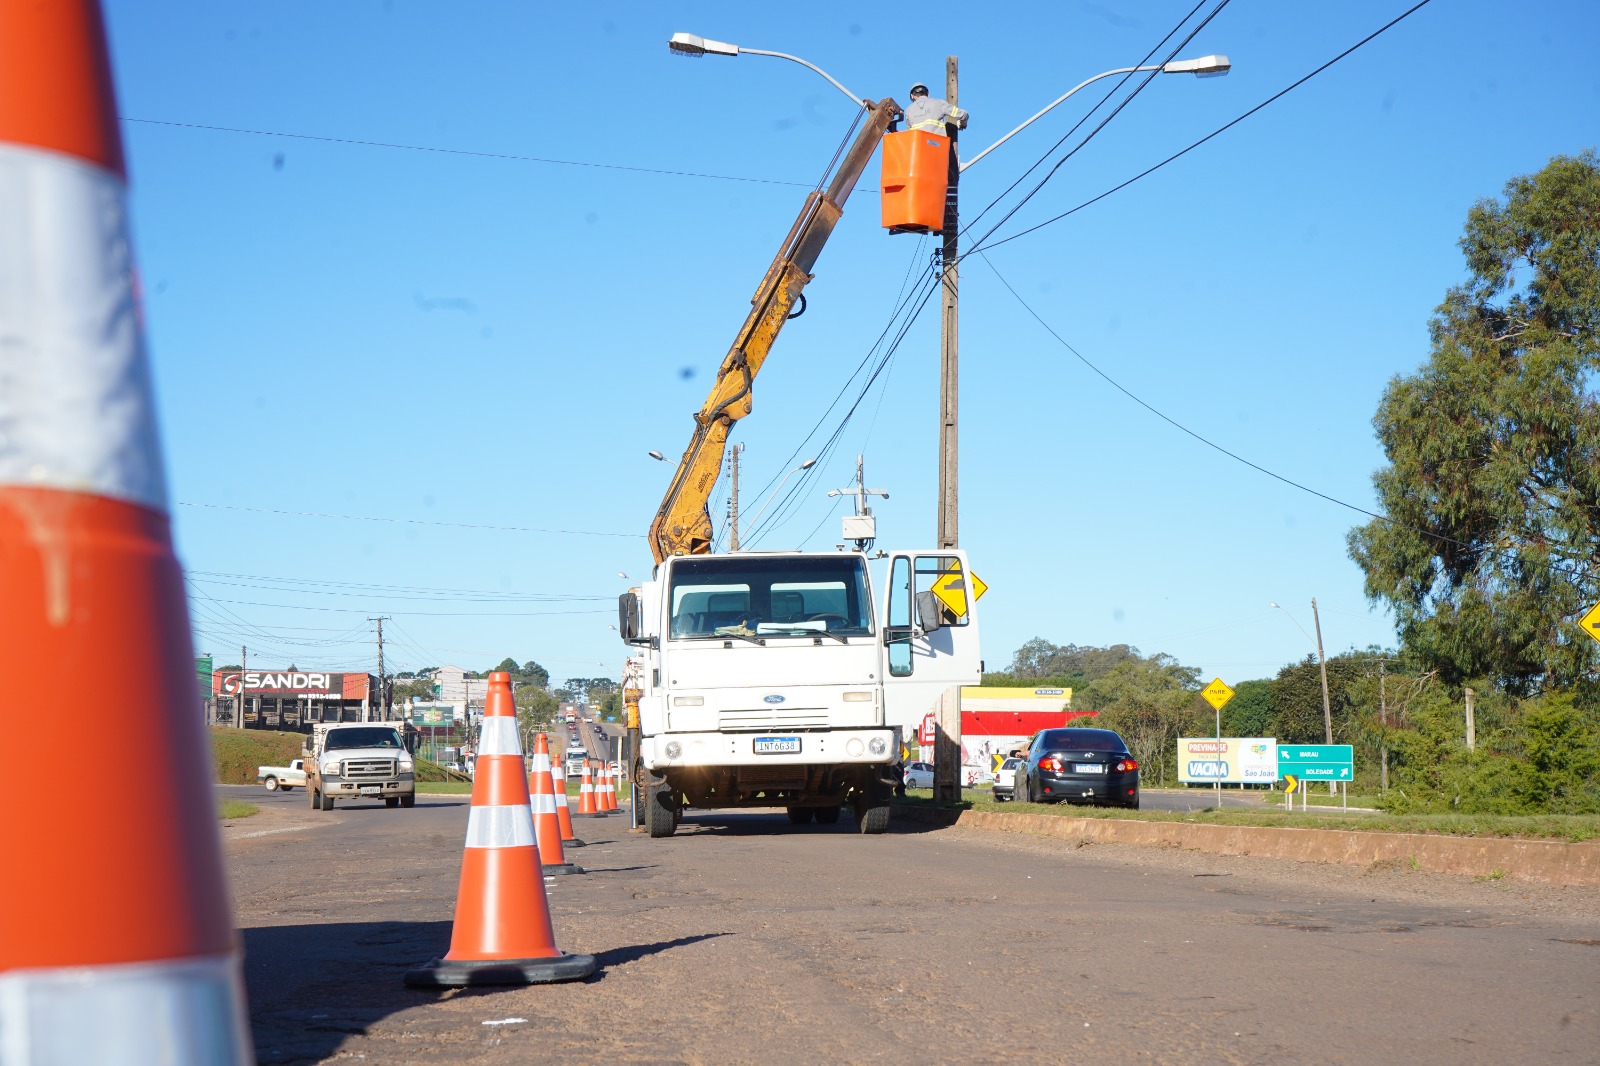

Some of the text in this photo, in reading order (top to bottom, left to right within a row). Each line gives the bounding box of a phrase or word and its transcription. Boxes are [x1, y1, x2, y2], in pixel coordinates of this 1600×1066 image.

[244, 673, 330, 688] SANDRI
[759, 742, 795, 751] INT6G38
[1188, 743, 1227, 752] PREVINA-SE
[1188, 762, 1228, 776] VACINA
